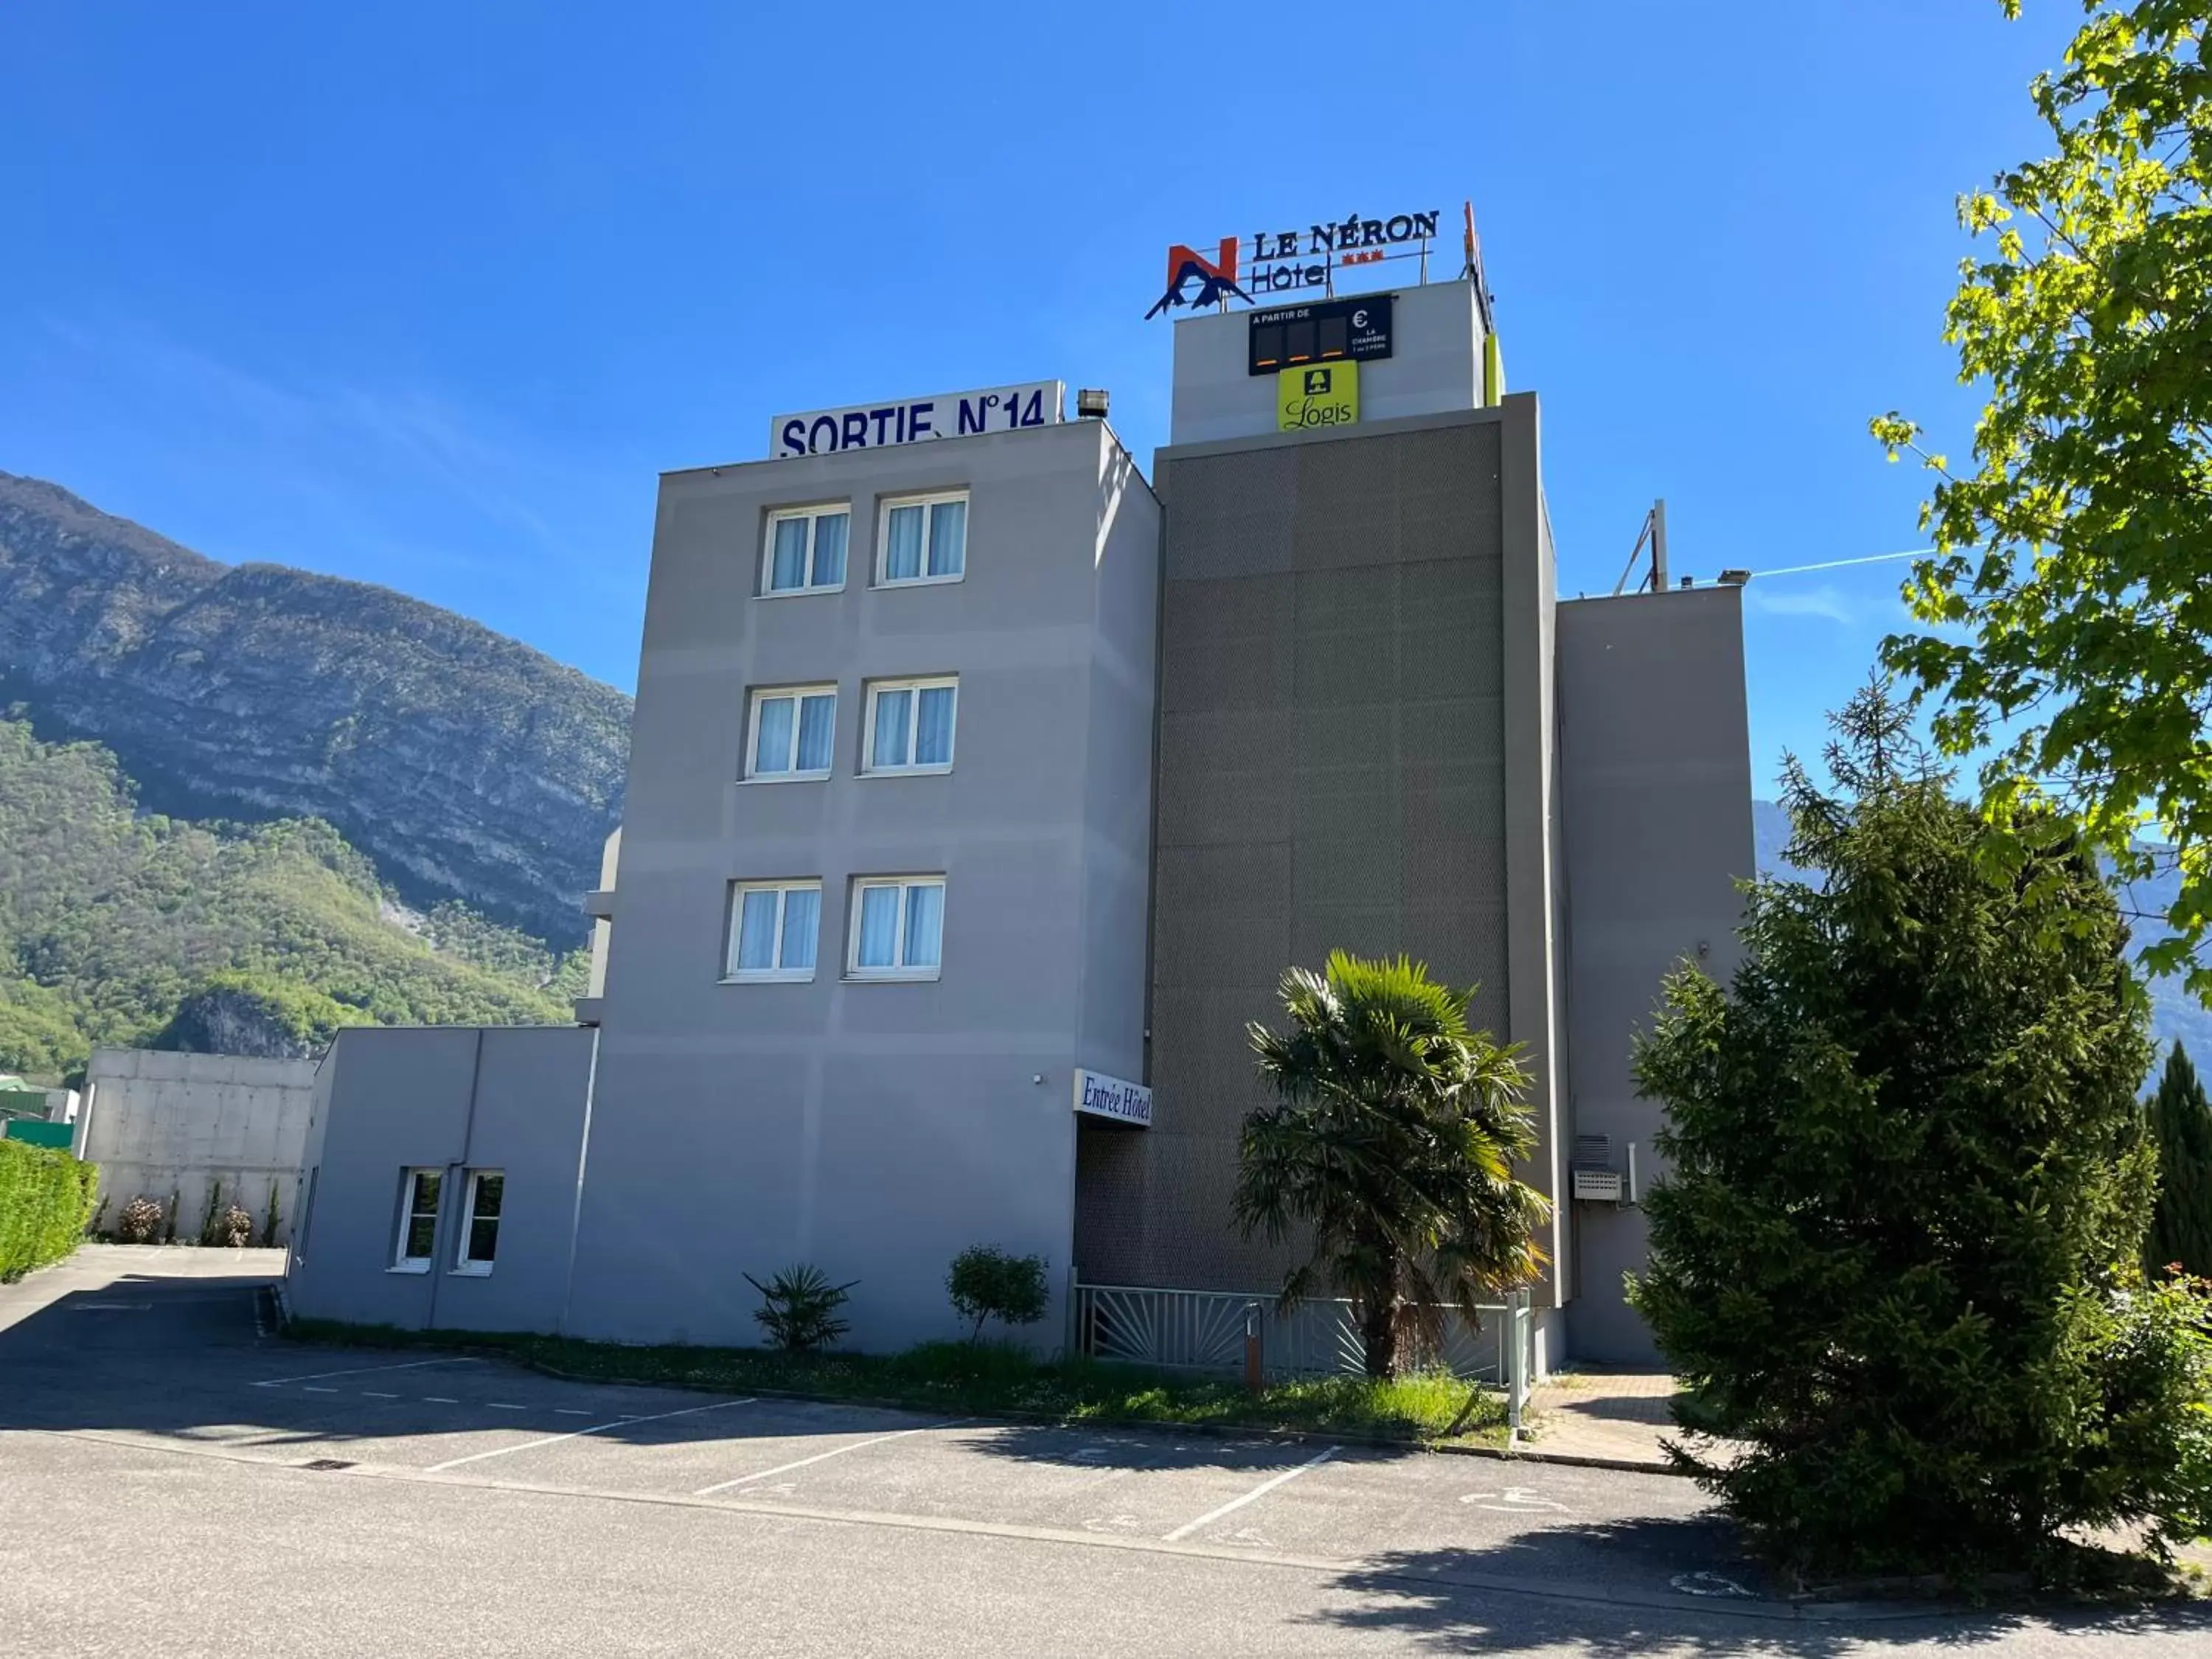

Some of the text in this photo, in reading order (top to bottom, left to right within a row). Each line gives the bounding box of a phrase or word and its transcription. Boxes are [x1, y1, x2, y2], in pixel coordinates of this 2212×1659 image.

[1253, 210, 1439, 262] LE NÉRON
[1252, 262, 1331, 295] Hôtel
[1262, 309, 1295, 323] PARTIR
[1297, 307, 1310, 319] DE
[779, 402, 935, 458] SORTIE
[1284, 396, 1351, 429] Logis
[1082, 1076, 1152, 1121] Entrée Hôtel
